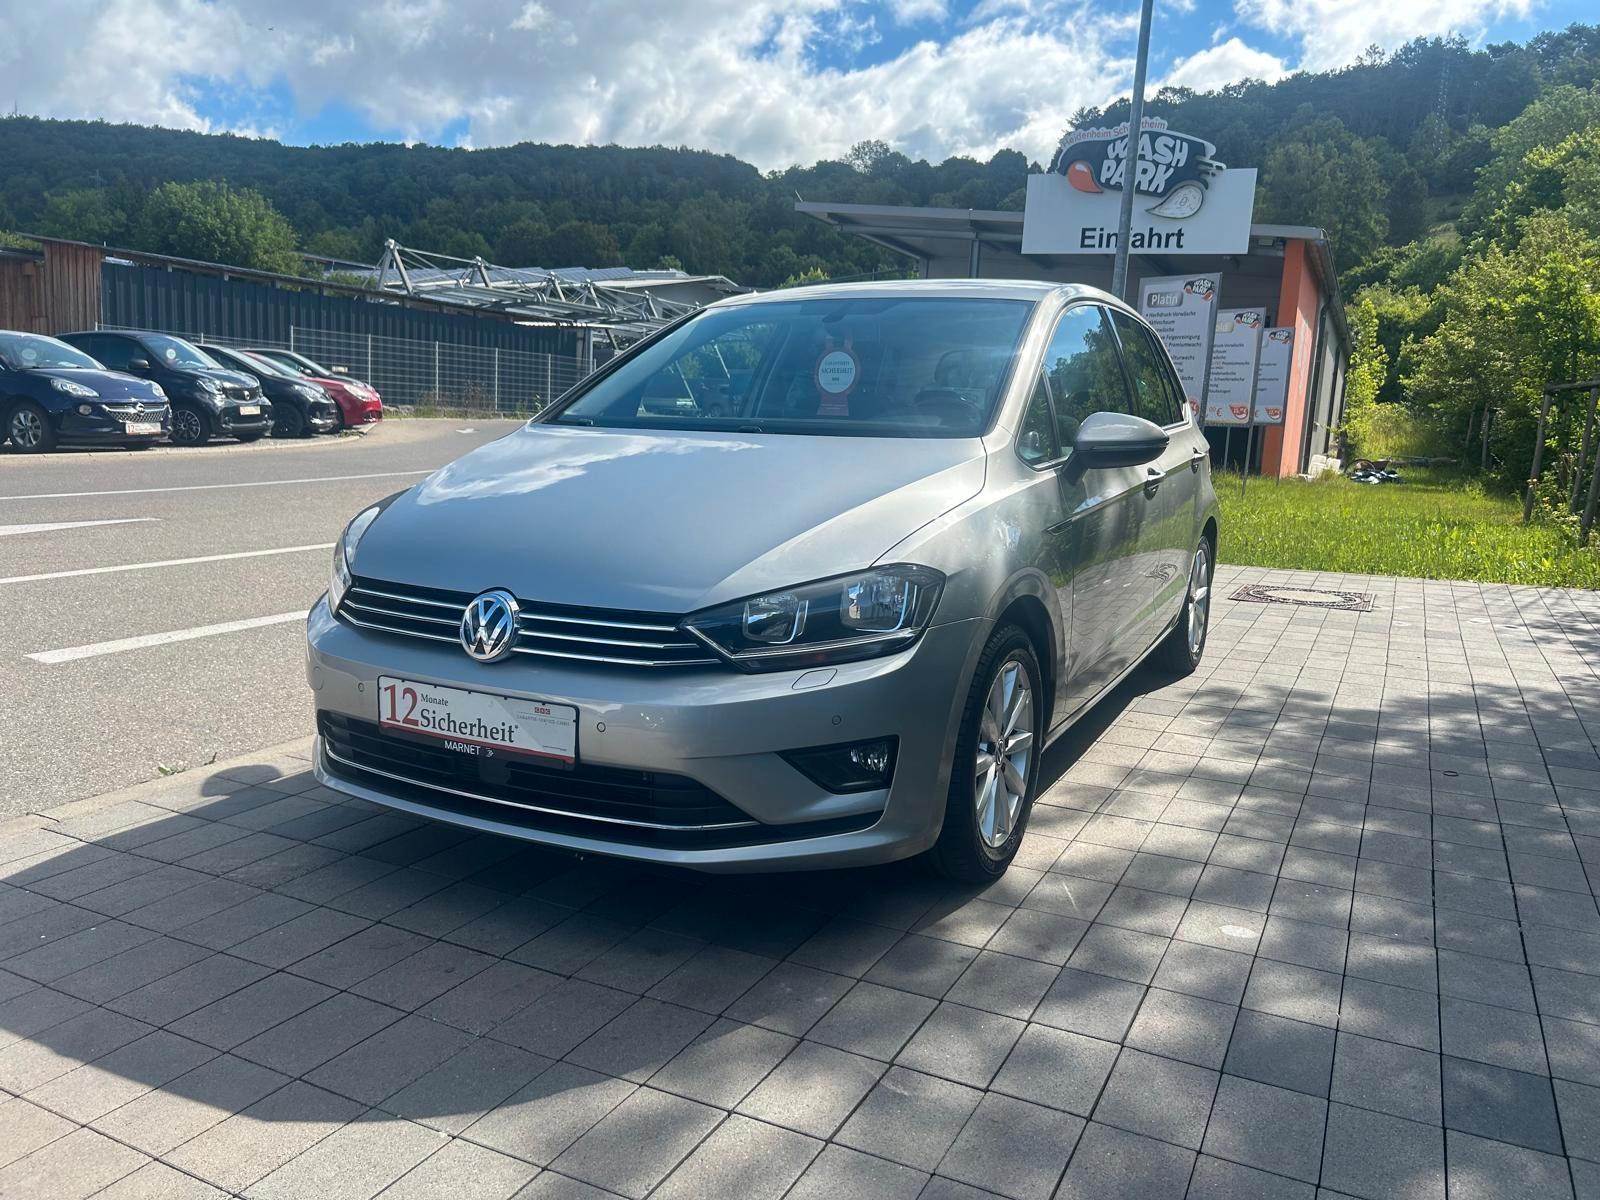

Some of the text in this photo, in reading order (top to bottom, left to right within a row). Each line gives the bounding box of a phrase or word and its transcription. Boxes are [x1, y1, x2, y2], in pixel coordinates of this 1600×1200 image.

[1080, 227, 1184, 249] Einahrt
[1151, 293, 1178, 305] Platin
[461, 594, 514, 660] VW
[384, 684, 449, 728] 12 Monate
[444, 740, 481, 756] MARNET
